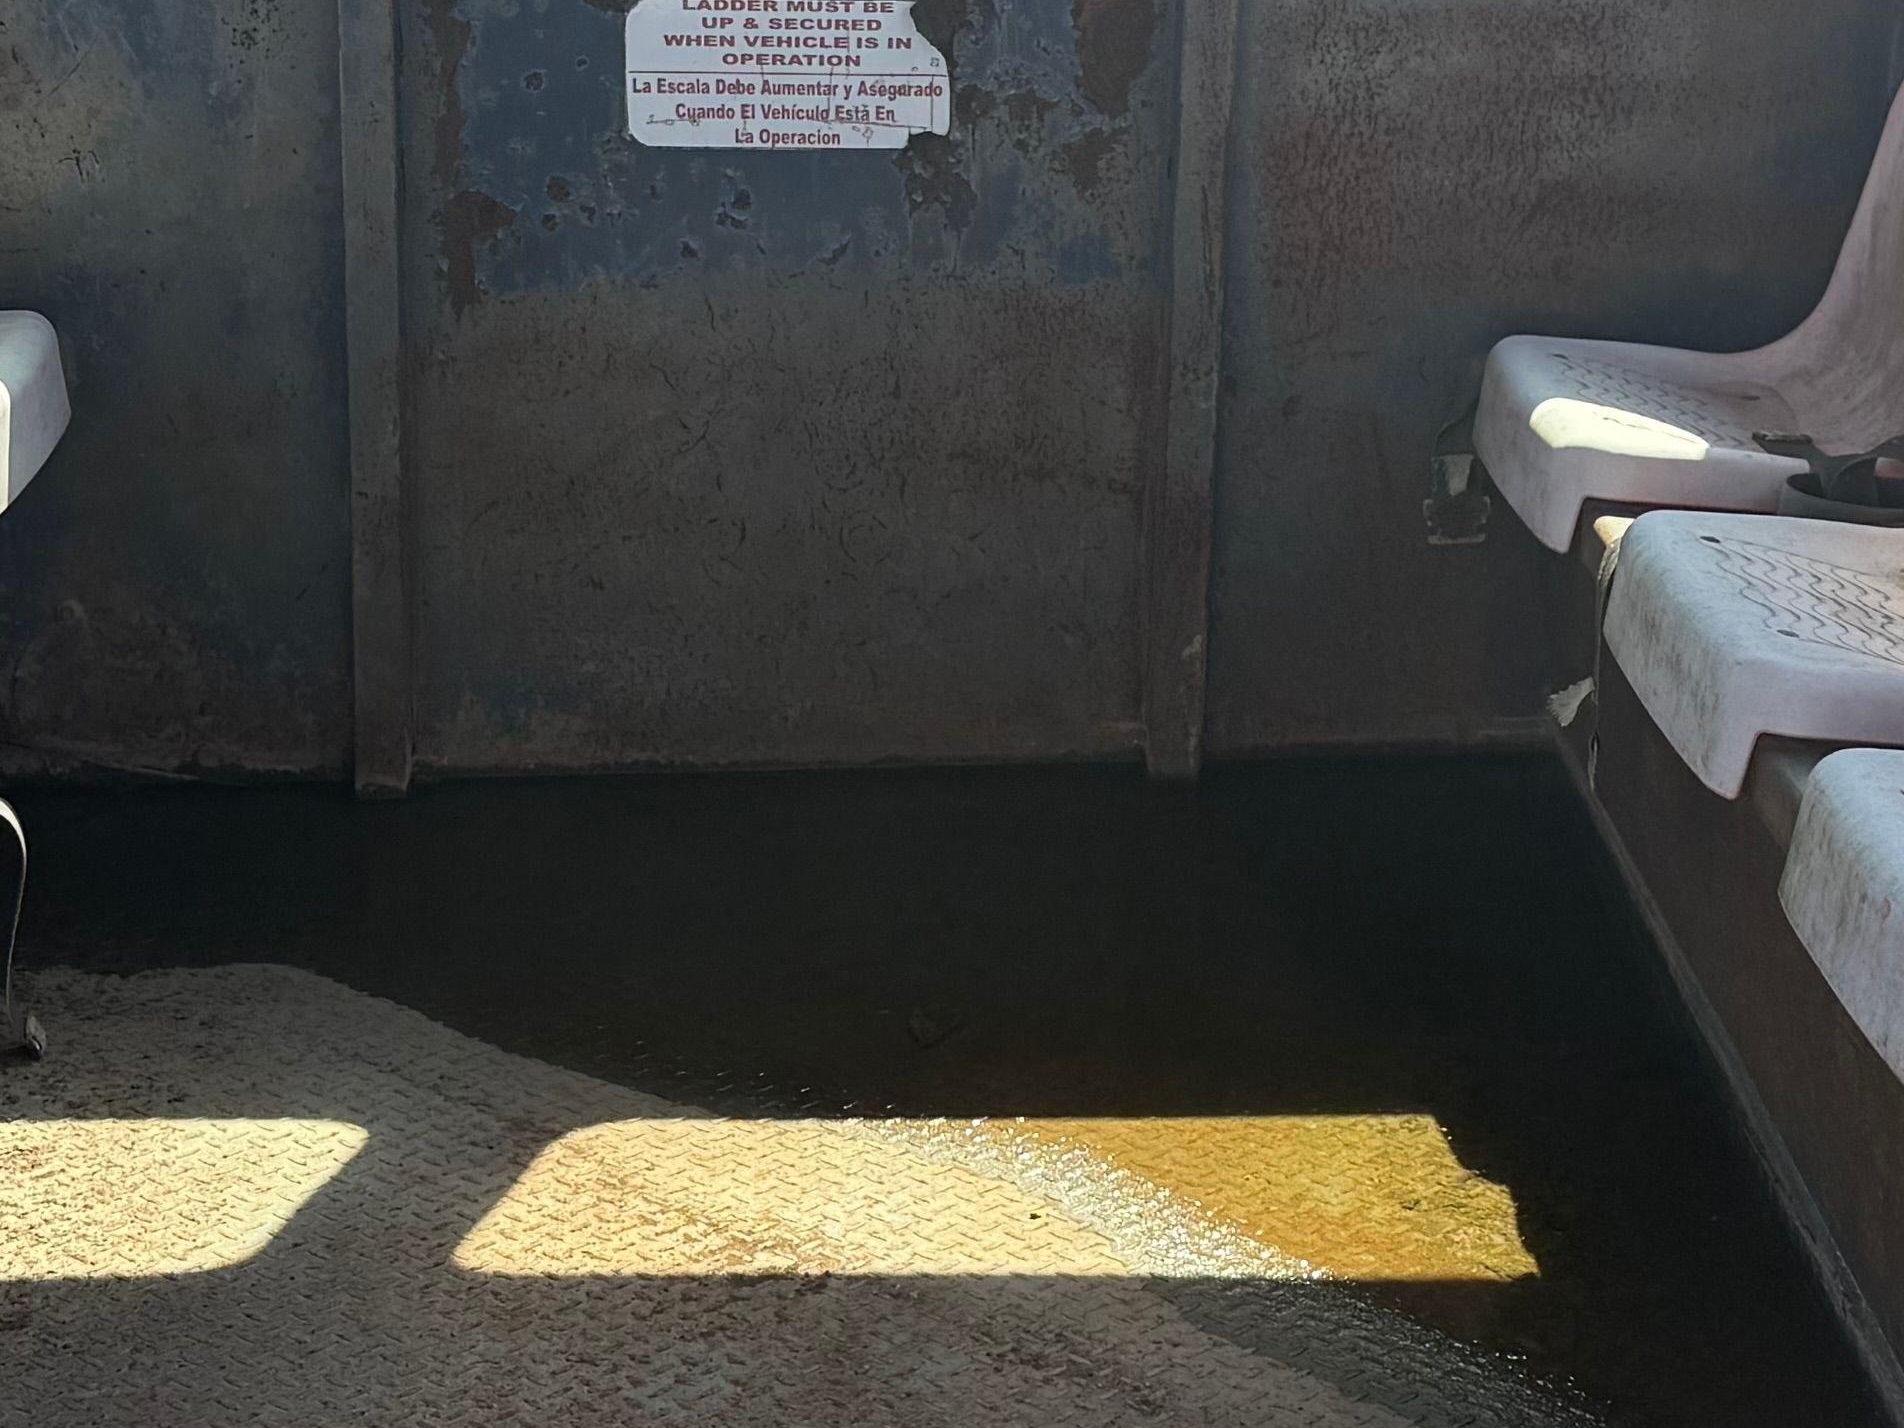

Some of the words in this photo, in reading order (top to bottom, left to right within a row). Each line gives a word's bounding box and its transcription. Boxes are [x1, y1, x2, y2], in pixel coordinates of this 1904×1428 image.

[681, 0, 778, 13] LADDER
[787, 0, 854, 13] MUST
[863, 1, 895, 14] BE
[701, 17, 734, 29] UP
[743, 17, 760, 29] &
[768, 18, 882, 31] SECURED
[663, 34, 736, 47] WHEN
[744, 35, 848, 49] VEHICLE
[856, 37, 880, 49] IS
[887, 37, 912, 49] IN
[722, 53, 861, 67] OPERATION
[632, 78, 651, 94] La
[657, 78, 711, 95] Escala
[715, 79, 756, 95] Debe
[761, 80, 838, 97] Aumentar
[843, 83, 853, 100] y
[857, 80, 943, 101] Asegurado
[675, 103, 735, 121] Cuando
[740, 103, 756, 120] El
[761, 103, 830, 121] Vehículo
[875, 106, 895, 121] En
[735, 128, 754, 144] La
